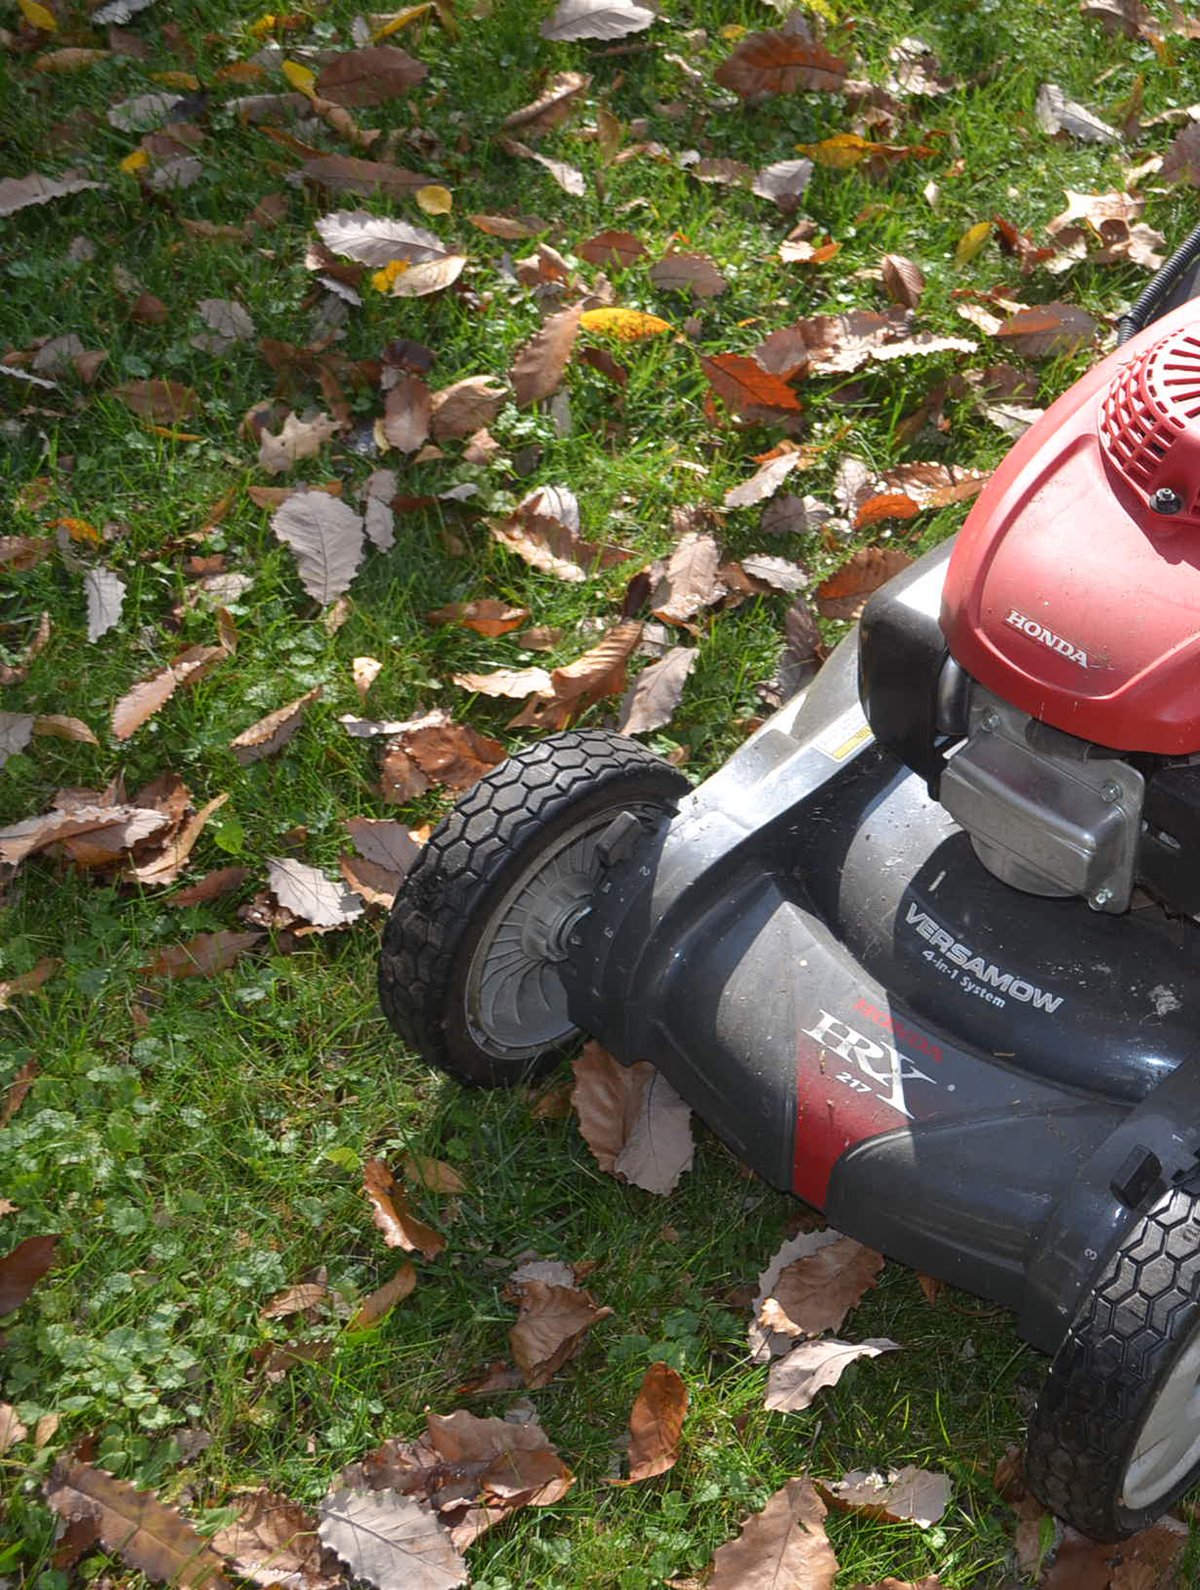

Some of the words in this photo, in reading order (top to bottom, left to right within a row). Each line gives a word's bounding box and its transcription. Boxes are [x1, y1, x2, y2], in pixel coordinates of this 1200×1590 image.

[1005, 609, 1088, 668] HONDA
[904, 901, 1065, 1014] VERSAMOW
[922, 949, 959, 980] 4-in-1
[959, 976, 1007, 1009] System
[852, 998, 945, 1063] HONDA
[801, 1009, 938, 1121] HRX
[835, 1071, 873, 1094] 217
[1084, 1247, 1098, 1261] 3
